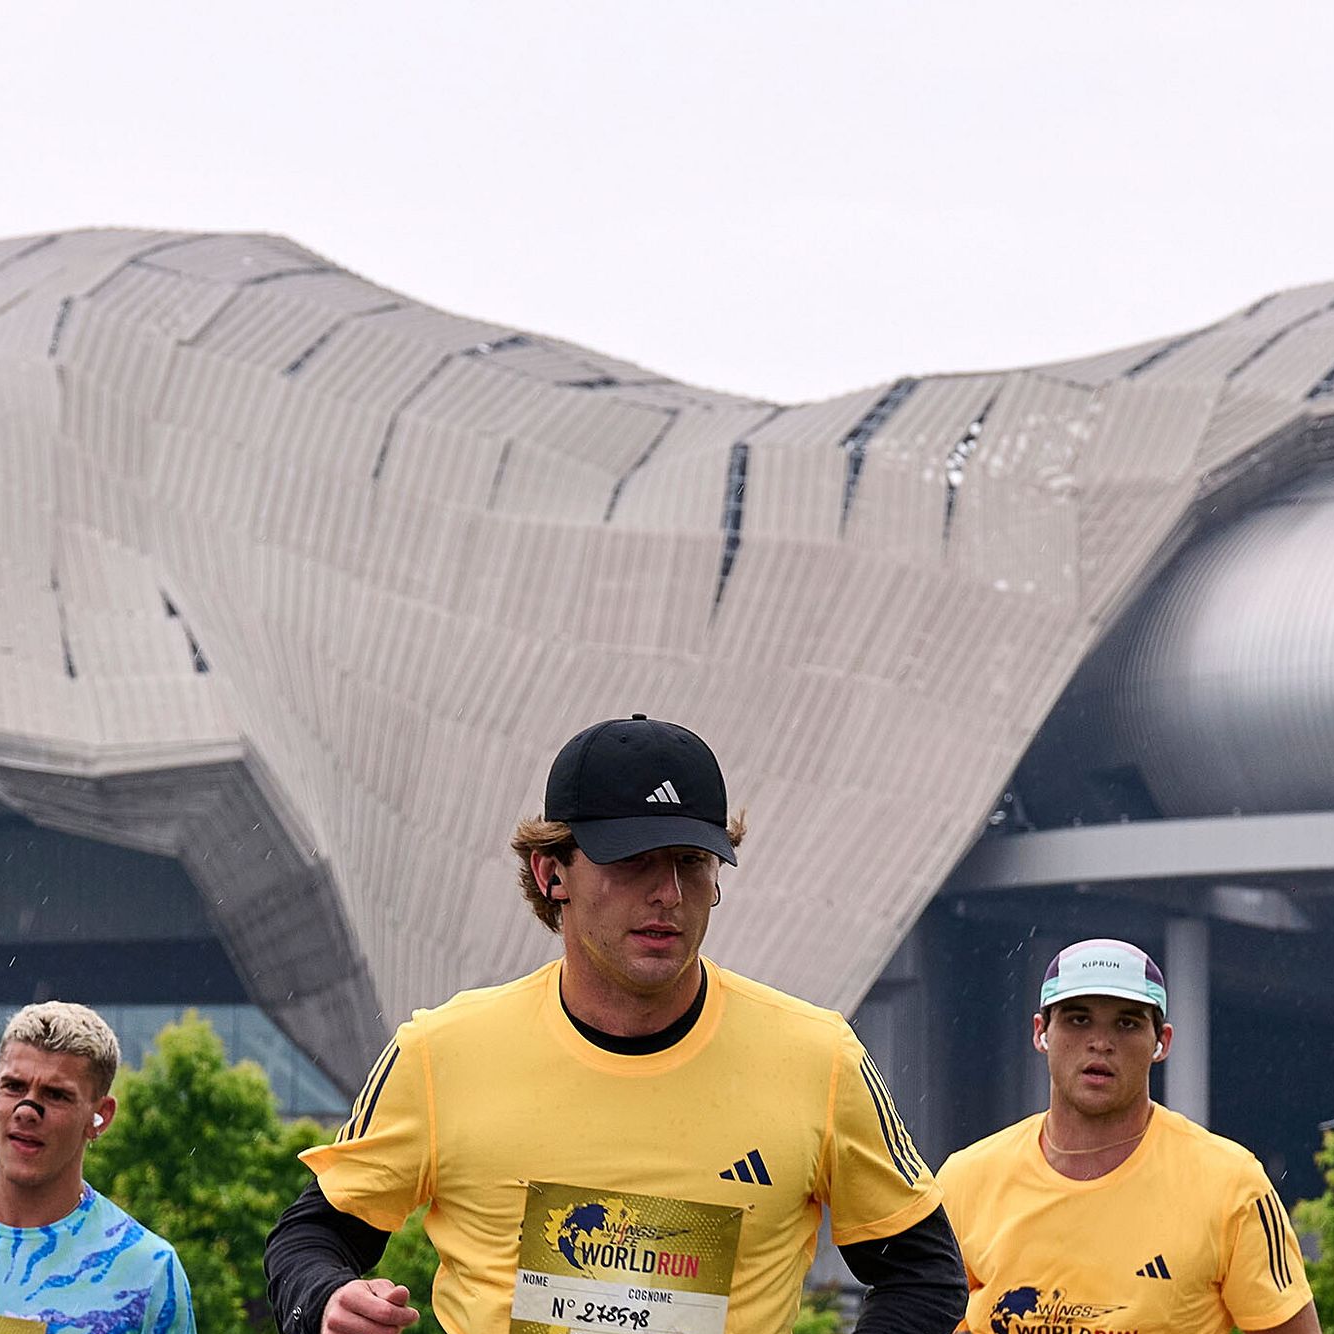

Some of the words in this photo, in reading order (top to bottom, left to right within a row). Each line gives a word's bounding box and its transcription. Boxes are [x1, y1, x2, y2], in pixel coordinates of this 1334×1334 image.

[1081, 960, 1120, 969] KIPRUN
[522, 1272, 549, 1288] NOME
[628, 1288, 674, 1304] COGNOME
[1038, 1302, 1093, 1318] WINGS
